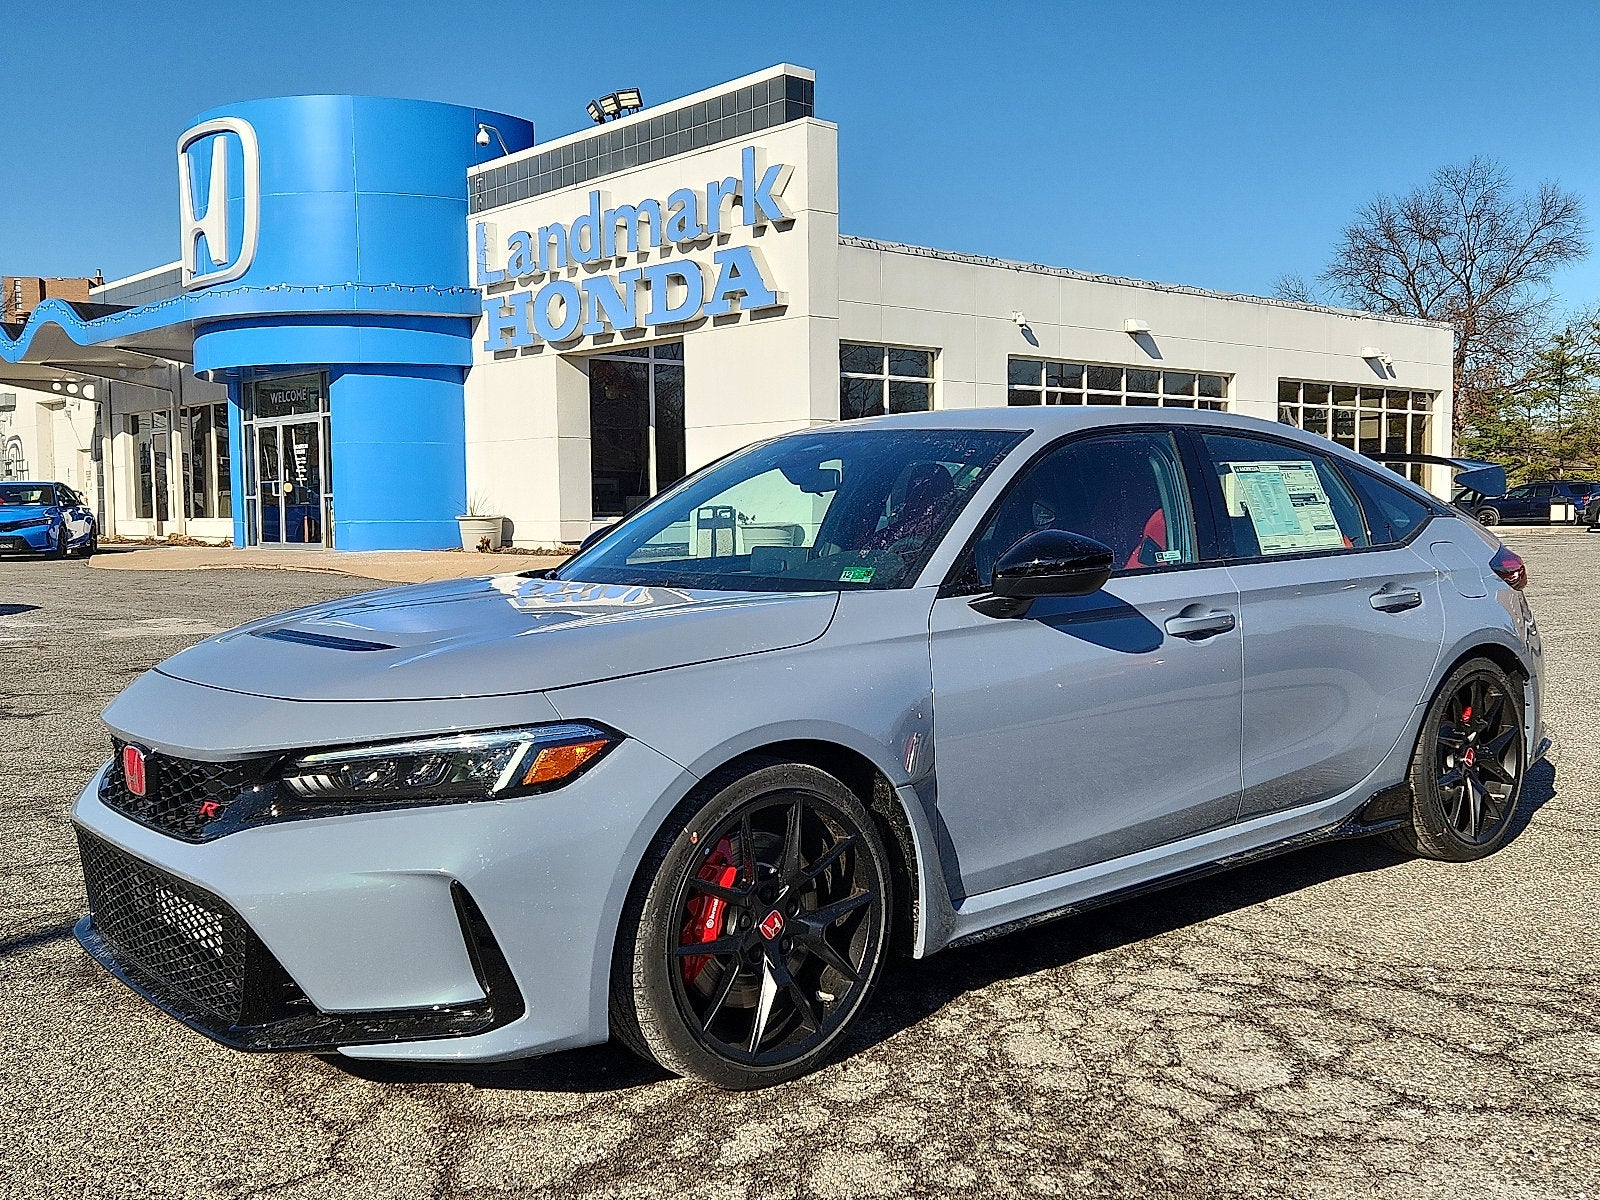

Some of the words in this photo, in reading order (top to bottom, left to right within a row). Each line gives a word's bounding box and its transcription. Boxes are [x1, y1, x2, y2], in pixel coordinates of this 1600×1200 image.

[476, 146, 786, 286] Landmark
[481, 245, 778, 352] HONDA
[269, 389, 307, 404] WELCOME
